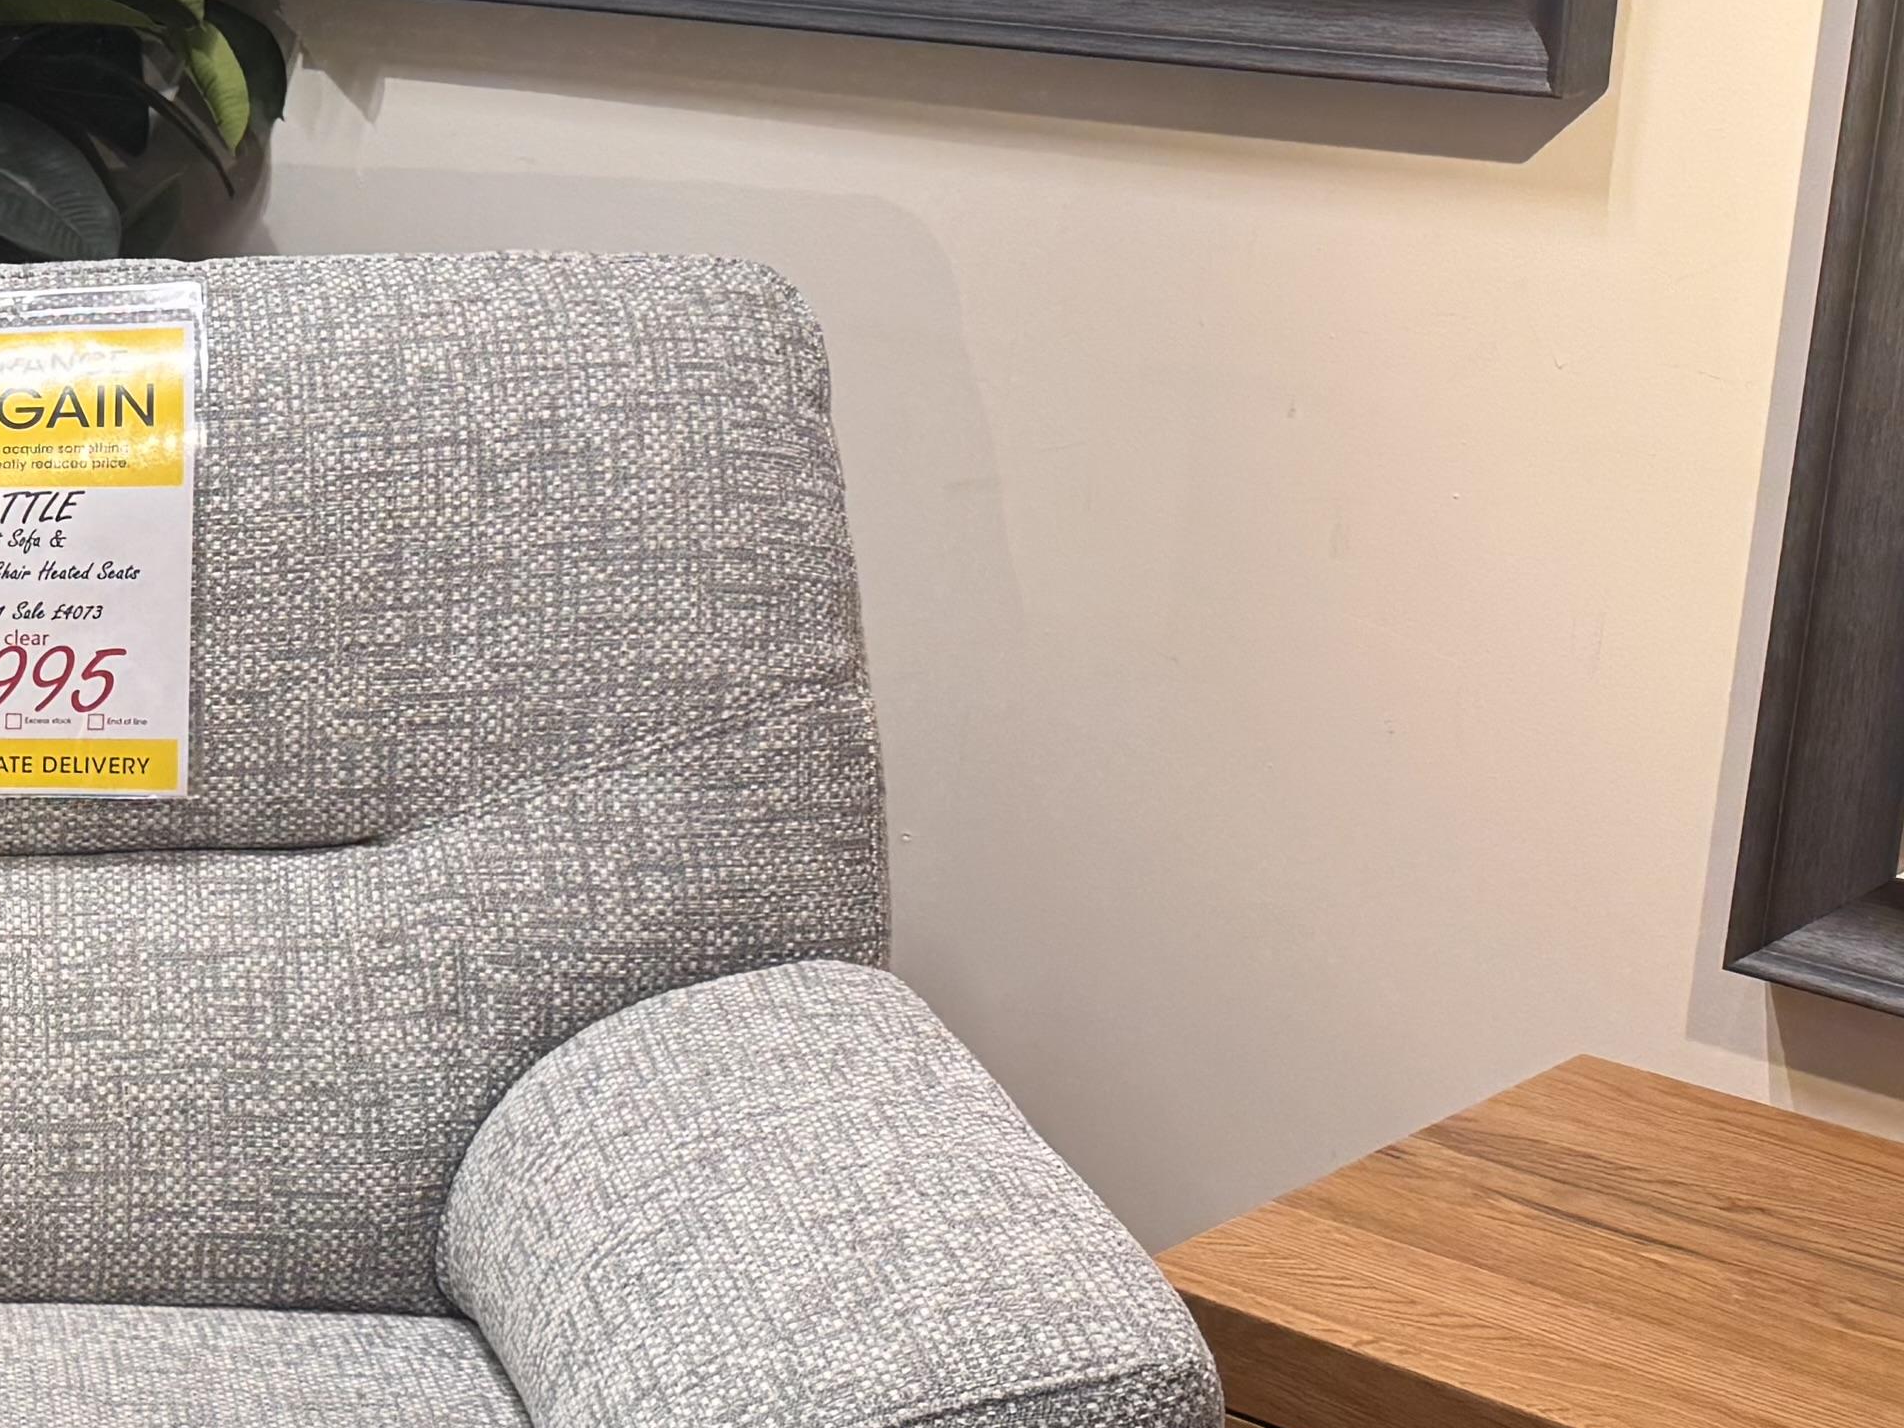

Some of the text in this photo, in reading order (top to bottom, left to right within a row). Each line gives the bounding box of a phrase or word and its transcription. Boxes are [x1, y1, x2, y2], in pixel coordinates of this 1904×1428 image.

[3, 444, 53, 456] acquire
[8, 528, 41, 555] Sofa
[50, 529, 67, 549] &
[38, 561, 90, 581] Heated
[97, 560, 141, 581] Seats
[12, 600, 46, 621] Sale
[50, 603, 104, 621] £4073
[4, 628, 50, 646] clear
[42, 755, 150, 775] DELIVERY
